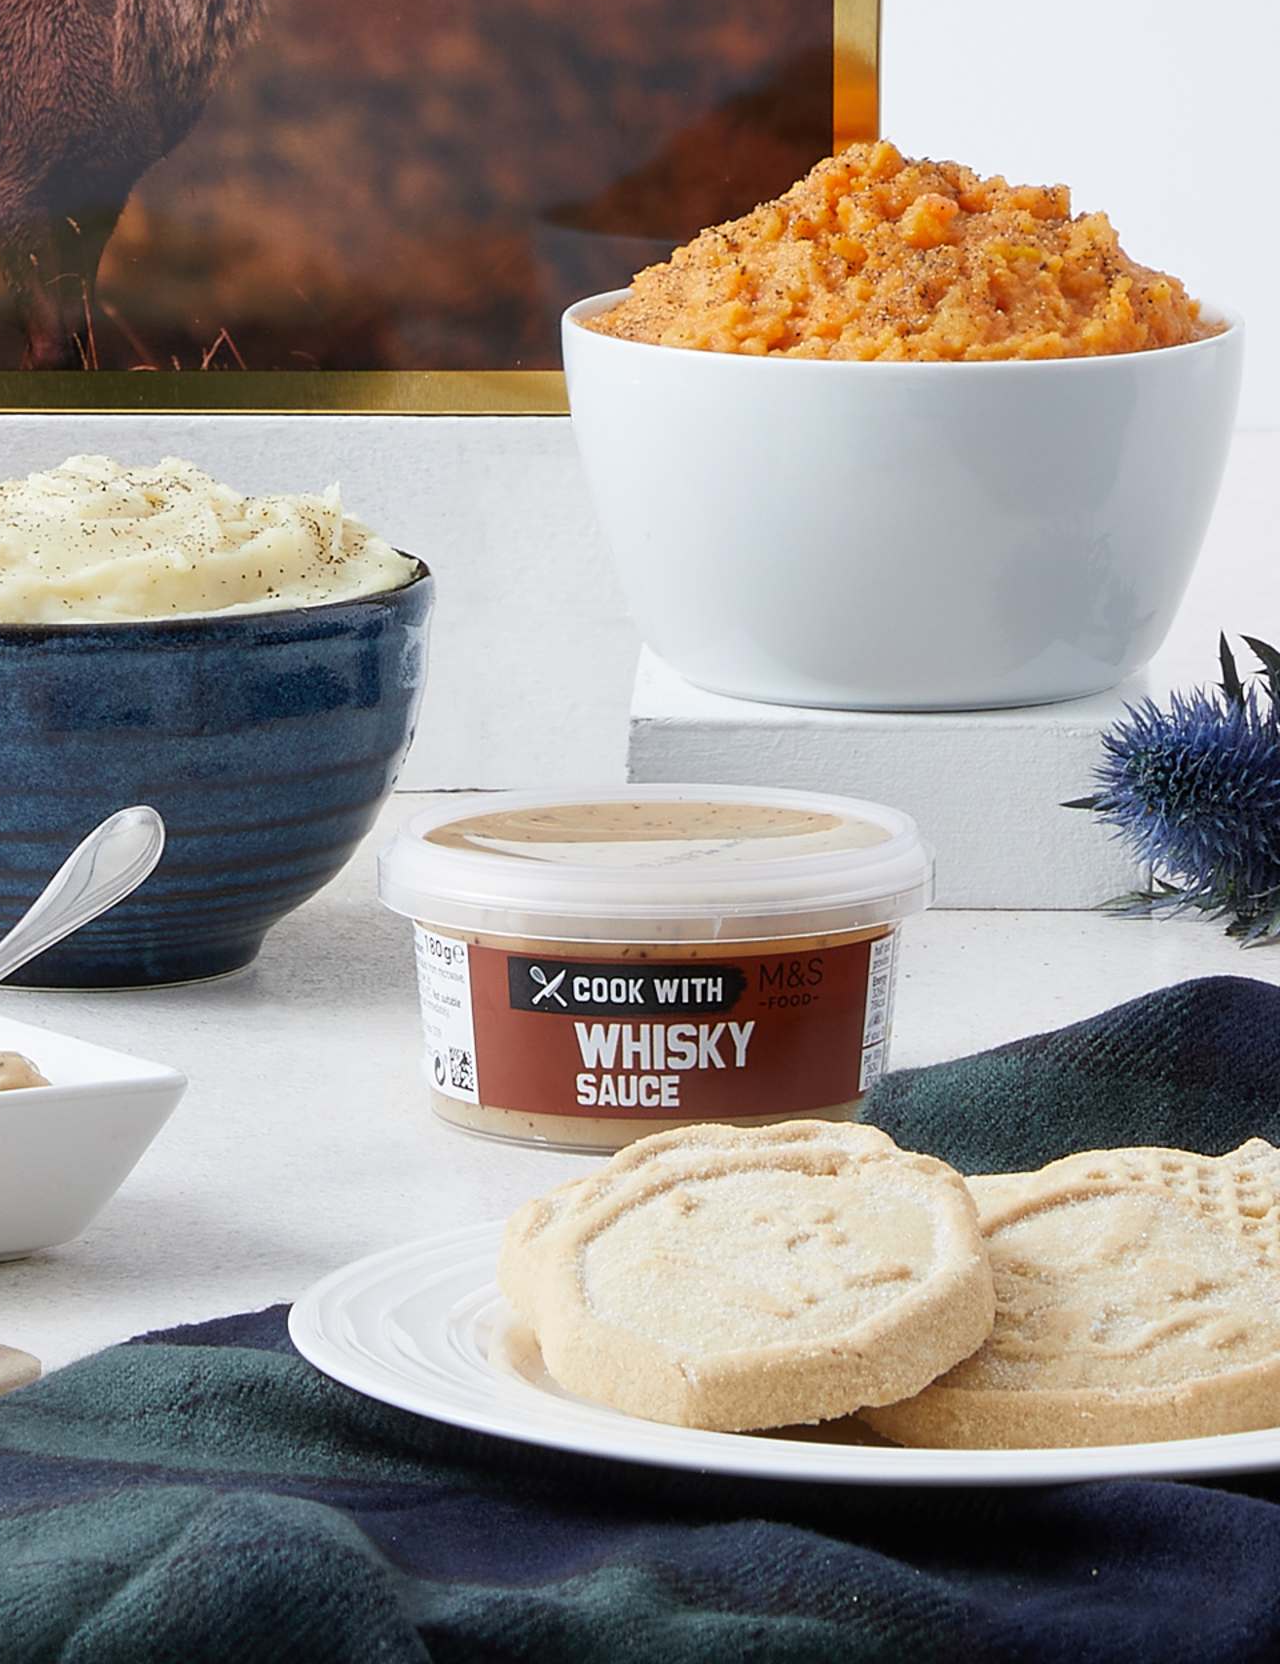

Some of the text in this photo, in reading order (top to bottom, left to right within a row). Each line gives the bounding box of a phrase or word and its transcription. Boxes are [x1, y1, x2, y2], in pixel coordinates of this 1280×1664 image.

[572, 975, 723, 1004] COOK WITH
[758, 957, 824, 993] M&S
[574, 1020, 756, 1072] WHISKY
[576, 1074, 681, 1109] SAUCE
